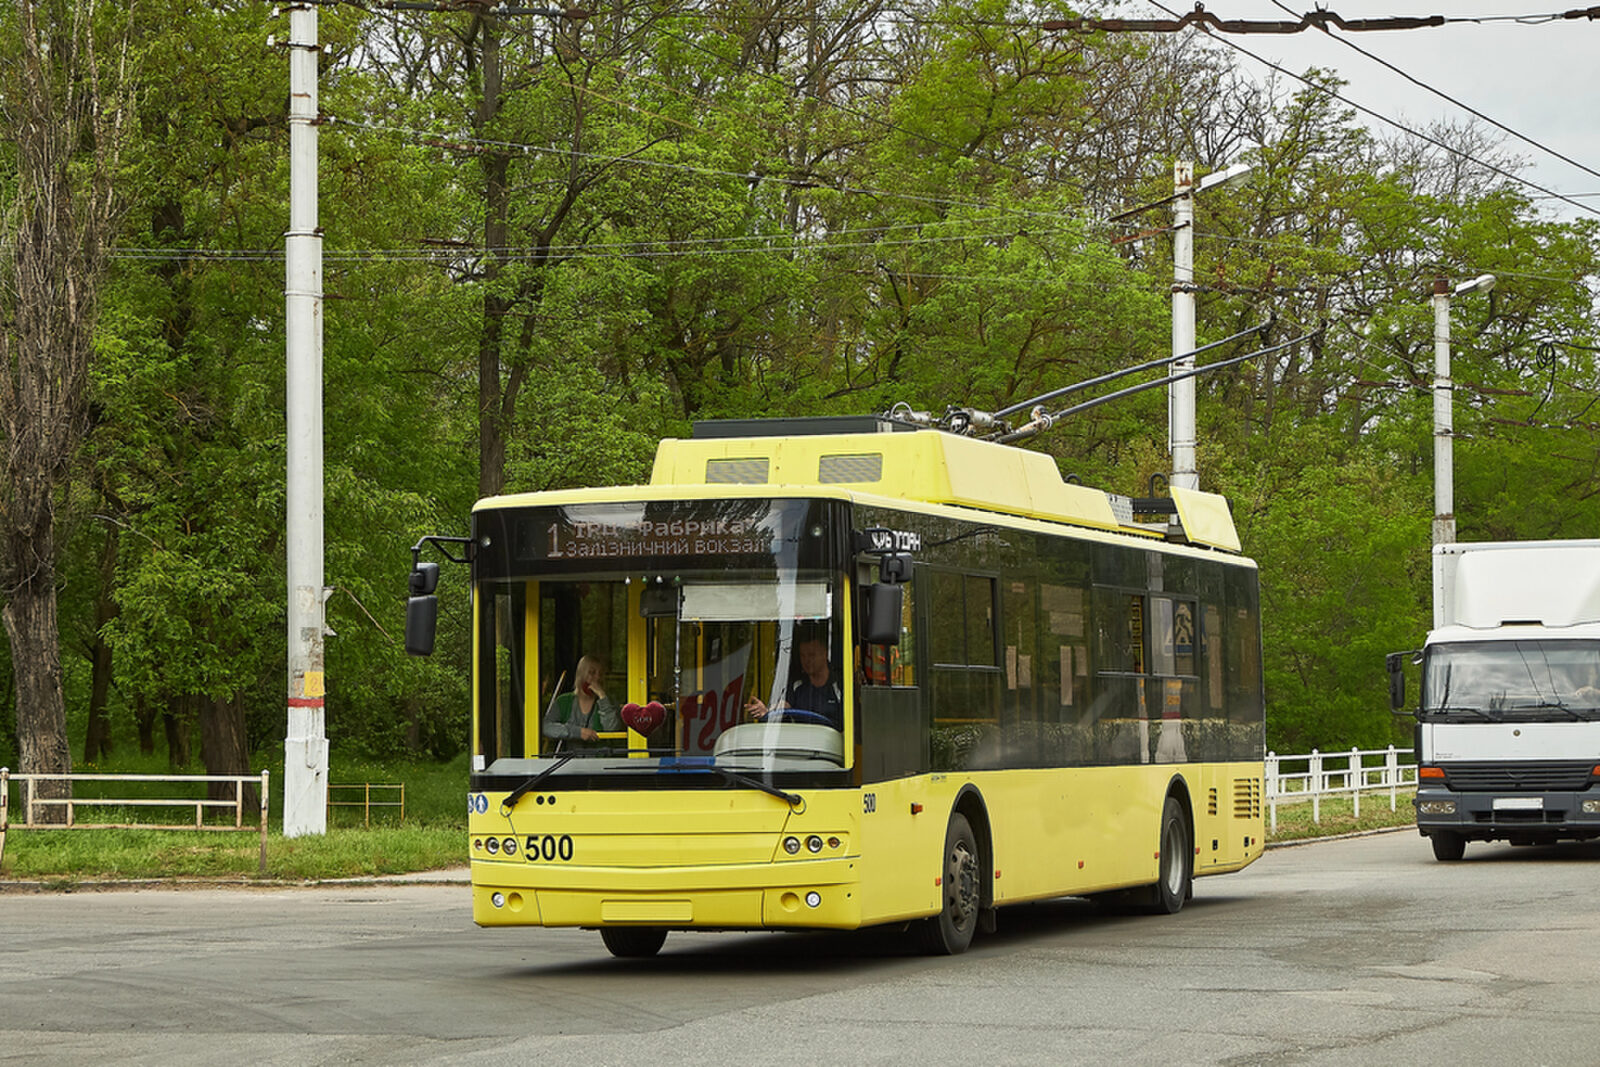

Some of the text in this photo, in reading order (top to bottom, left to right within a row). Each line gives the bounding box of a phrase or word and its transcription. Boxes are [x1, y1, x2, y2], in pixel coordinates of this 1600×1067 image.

[547, 523, 564, 557] 1
[566, 539, 689, 557] Залізничний
[864, 793, 876, 814] 500
[525, 834, 574, 861] 500
